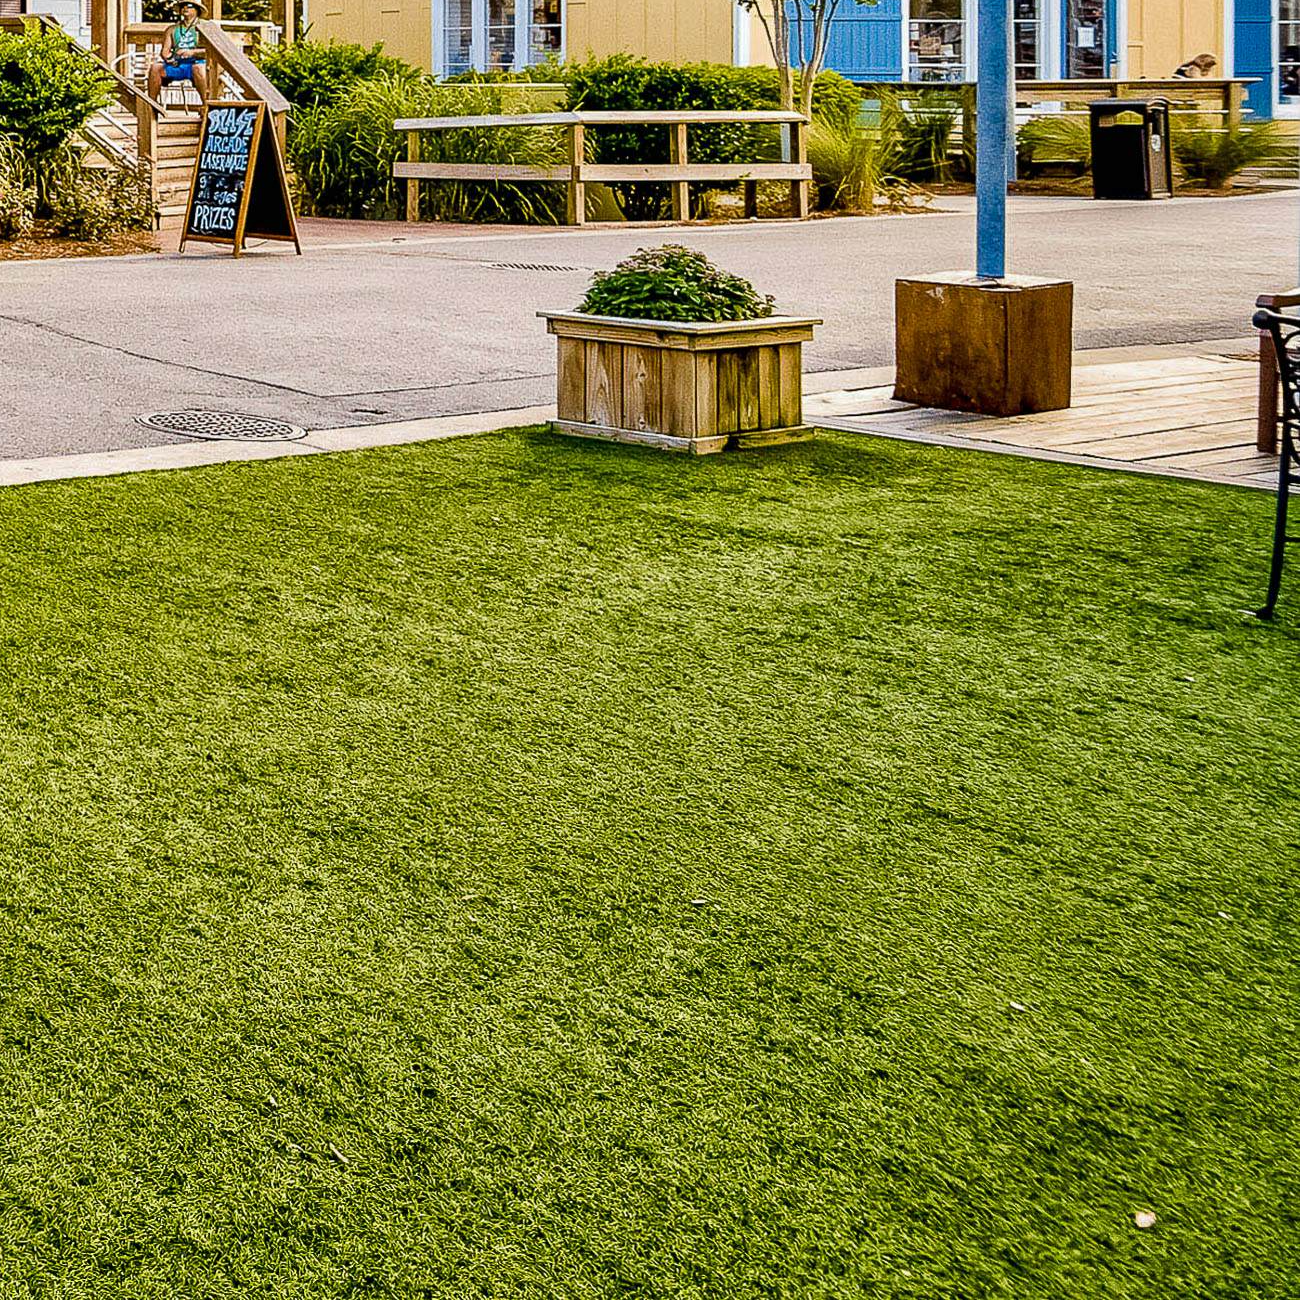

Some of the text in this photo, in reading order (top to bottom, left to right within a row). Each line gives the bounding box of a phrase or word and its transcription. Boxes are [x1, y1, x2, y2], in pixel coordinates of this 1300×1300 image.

[207, 108, 257, 138] BLAST
[205, 134, 250, 154] ARCADE
[193, 205, 236, 230] PRIZES
